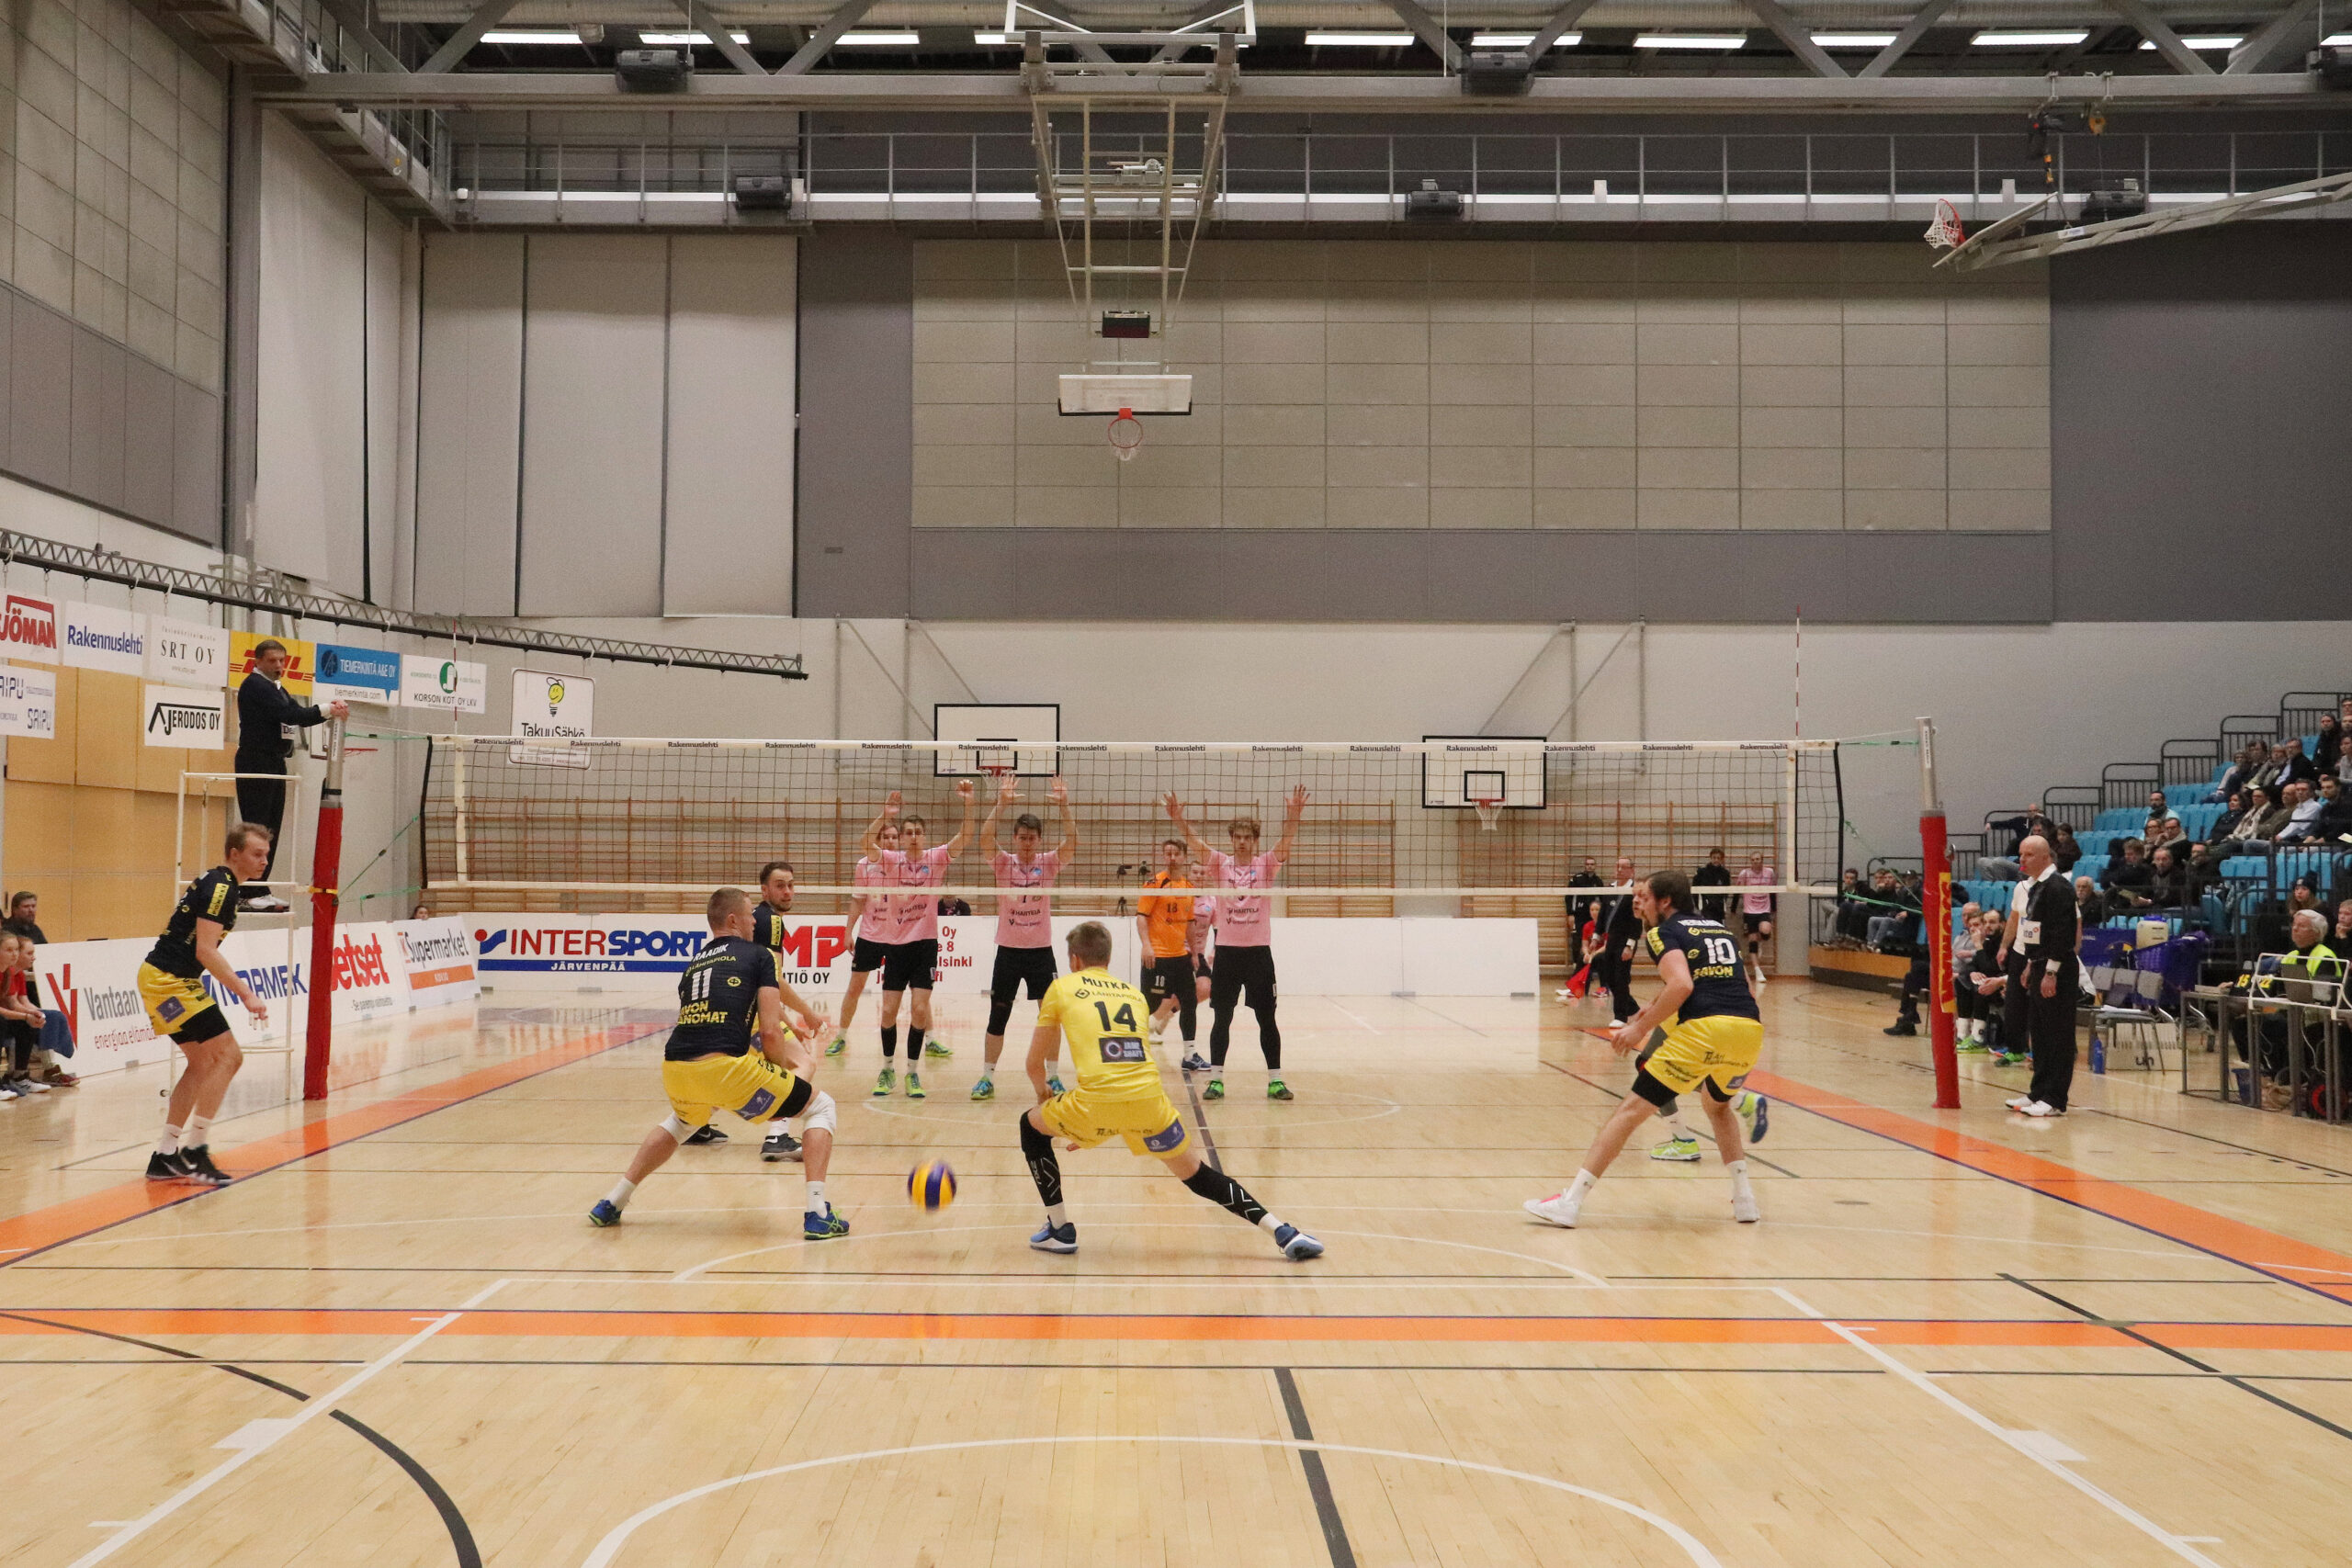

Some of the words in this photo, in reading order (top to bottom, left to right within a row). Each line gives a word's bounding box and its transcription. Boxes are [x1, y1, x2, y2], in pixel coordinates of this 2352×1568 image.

[0, 607, 57, 649] JÖMAN
[67, 624, 143, 655] Rakennuslehti
[161, 639, 187, 660] SRT
[196, 646, 215, 664] OY
[0, 675, 24, 699] AIPU
[413, 693, 441, 704] KORSON
[443, 695, 456, 705] KOT
[209, 712, 220, 730] OY
[474, 738, 525, 746] Rakennuslehti
[570, 739, 621, 748] Rakennuslehti
[668, 740, 718, 749] Rakennuslehti
[765, 741, 816, 750] Rakennuslehti
[862, 742, 912, 750] Rakennuslehti
[958, 743, 1010, 751] Rakennuslehti
[1154, 744, 1205, 752] Rakennuslehti
[1251, 744, 1303, 752] Rakennuslehti
[1350, 744, 1401, 752] Rakennuslehti
[1446, 744, 1498, 752] Rakennuslehti
[1544, 744, 1596, 752] Rakennuslehti
[1642, 743, 1693, 751] Rakennuslehti
[942, 926, 957, 938] Oy
[404, 929, 469, 968] Supermarket
[510, 930, 707, 957] INTERSPORT
[946, 942, 955, 952] 8
[693, 943, 729, 962] RAADIK
[1703, 937, 1736, 964] 10
[331, 932, 390, 992] etset
[550, 960, 626, 972] JÄRVENPÄÄ
[939, 955, 973, 967] lsinki
[691, 967, 713, 1001] 11
[812, 972, 831, 984] OY
[1081, 976, 1130, 990] MUTKA
[84, 986, 141, 1021] Vantaan
[677, 1011, 729, 1025] ANOMAT
[1094, 1000, 1137, 1032] 14
